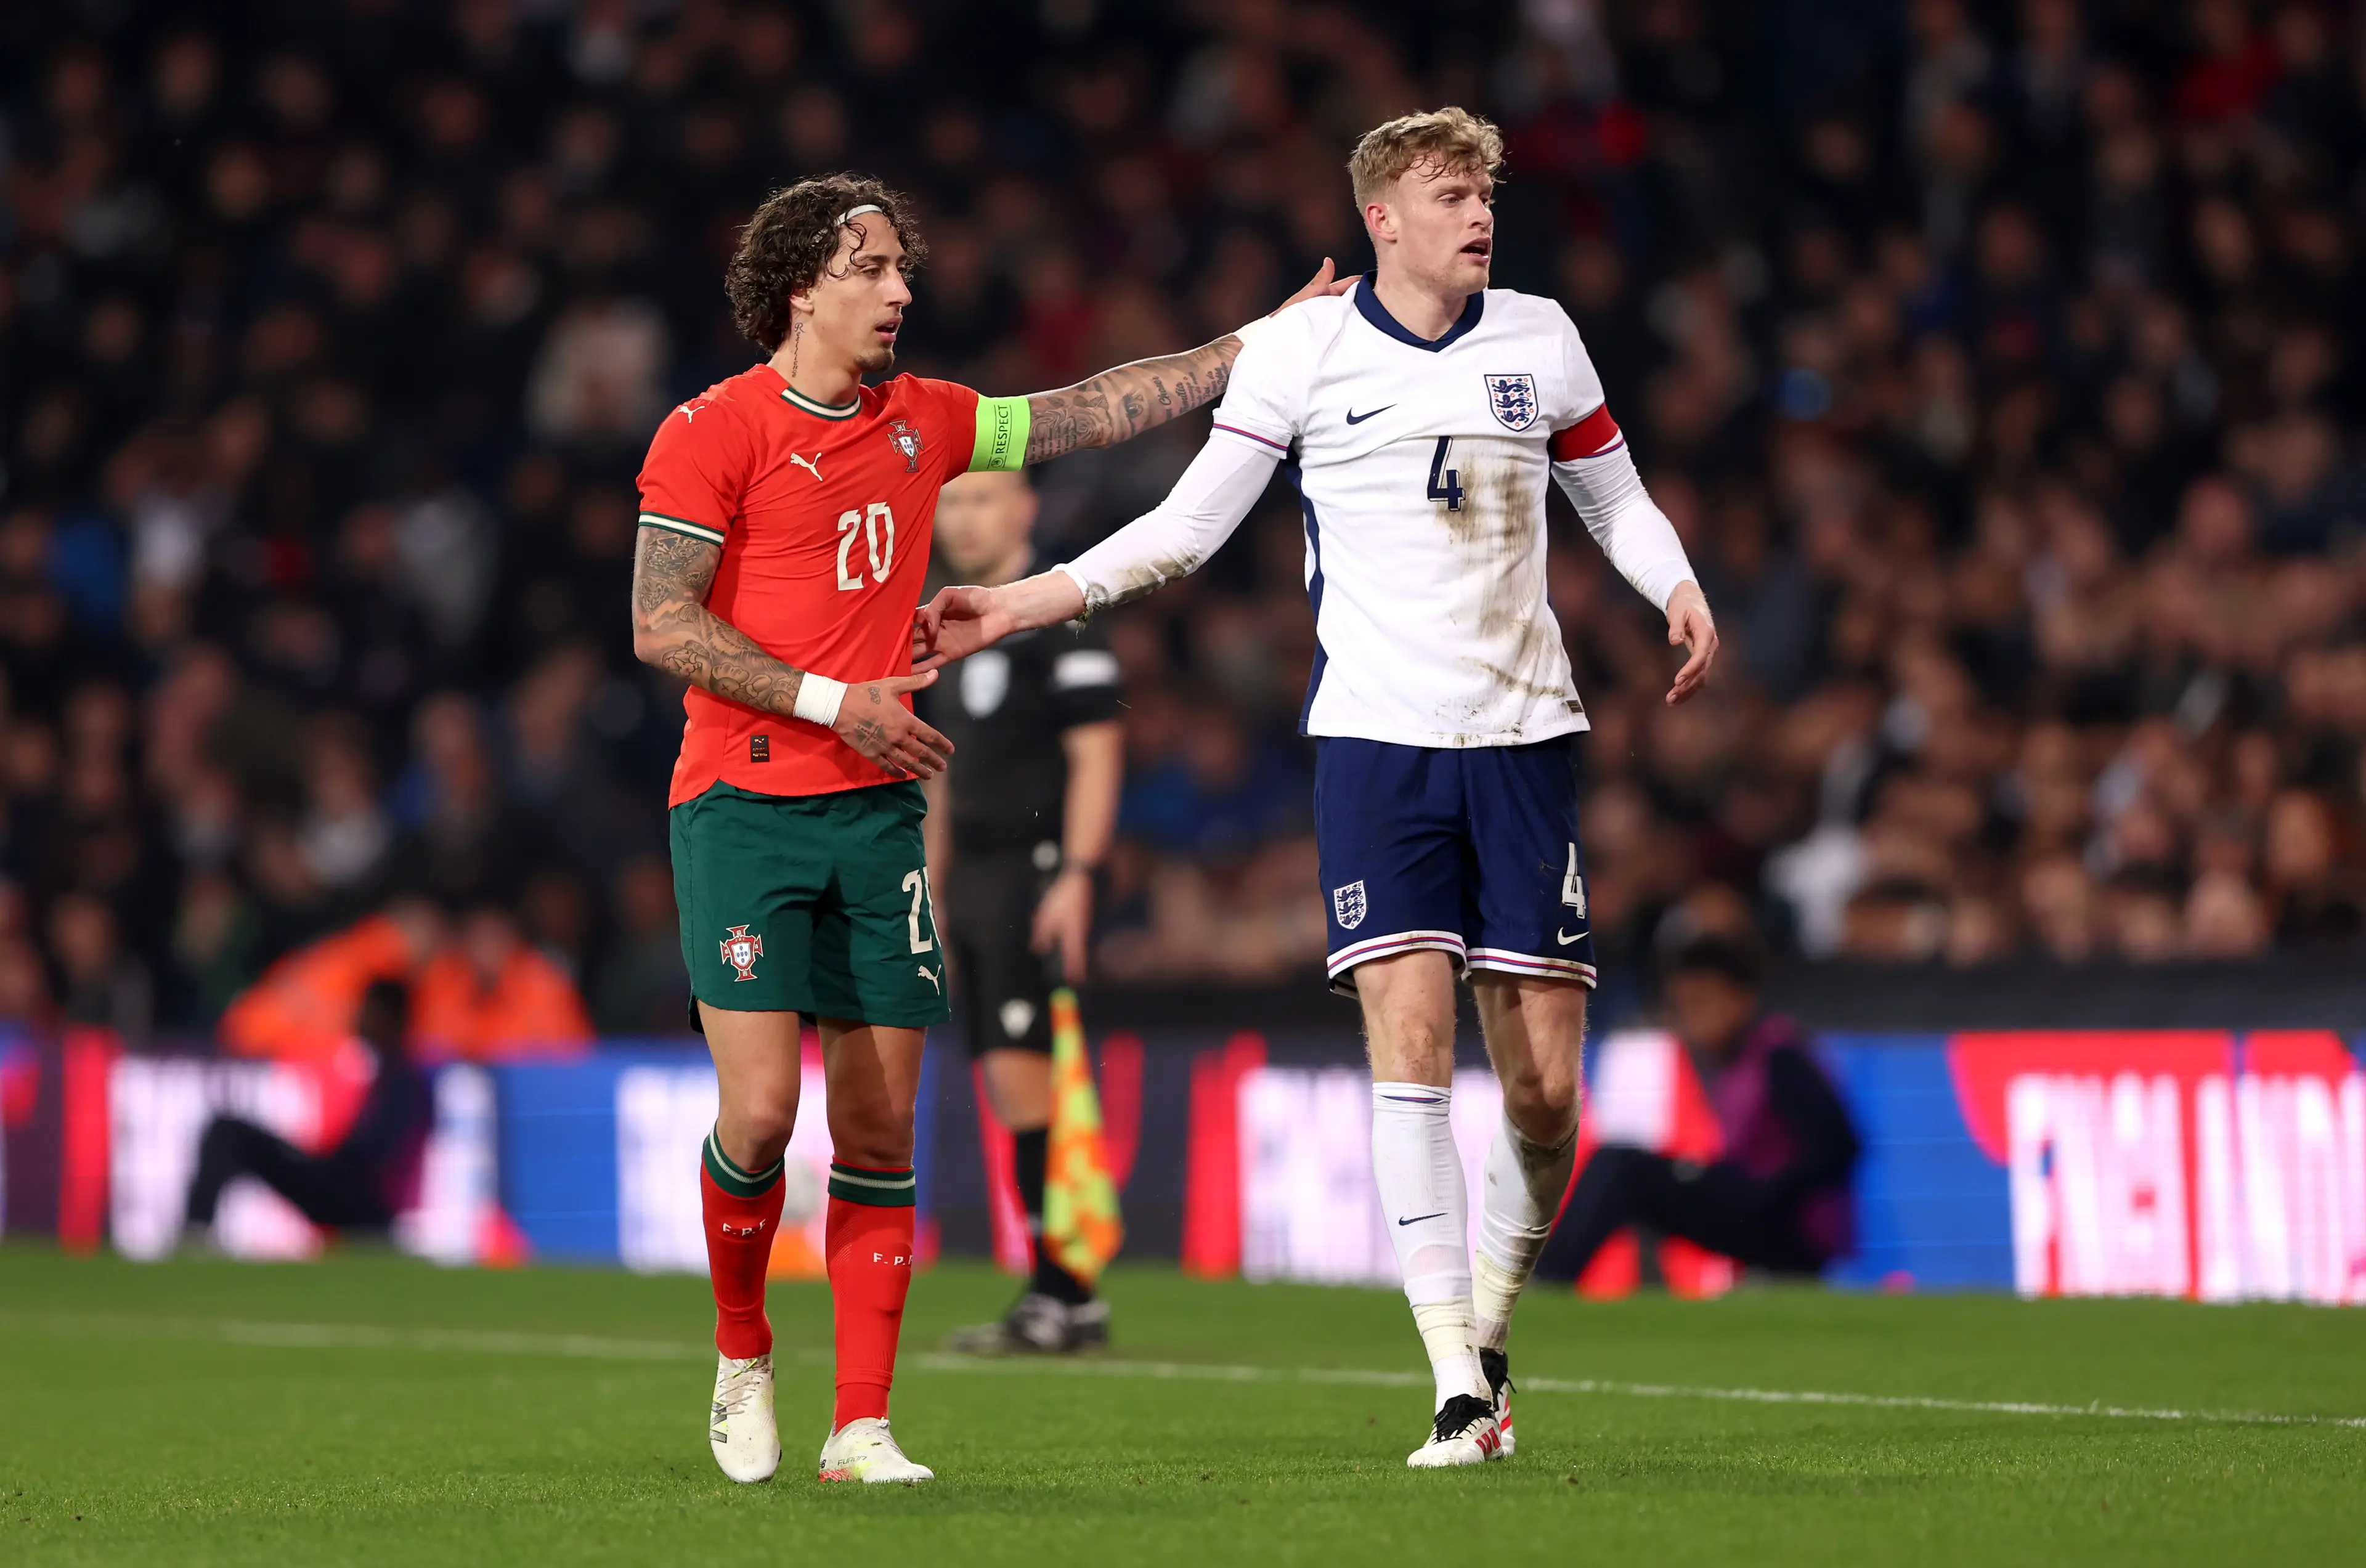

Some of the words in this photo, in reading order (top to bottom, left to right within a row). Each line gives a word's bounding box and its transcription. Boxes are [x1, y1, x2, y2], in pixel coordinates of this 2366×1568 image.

[995, 405, 1009, 454] RESPECT
[1427, 436, 1466, 511] 4
[837, 501, 895, 591] 20
[1562, 842, 1587, 919] 4
